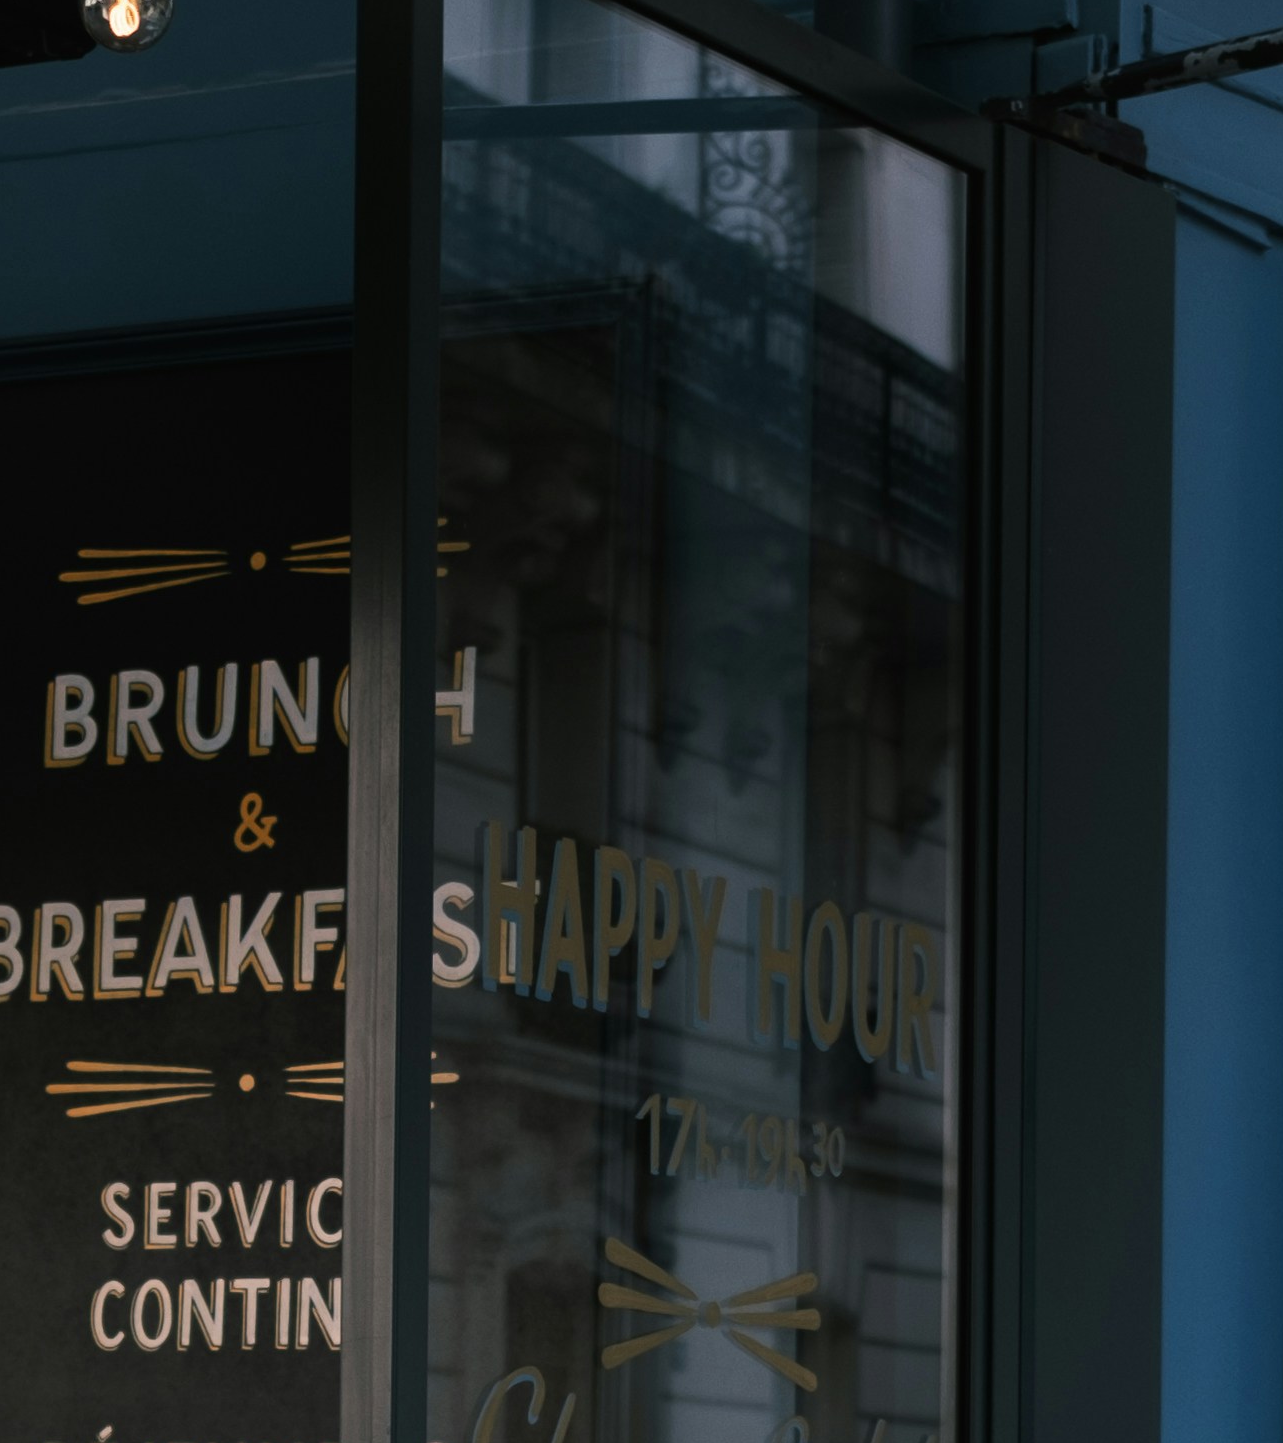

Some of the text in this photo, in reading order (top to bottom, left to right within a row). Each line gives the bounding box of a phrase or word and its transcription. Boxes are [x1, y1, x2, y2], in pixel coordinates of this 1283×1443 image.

[43, 646, 477, 769] BRUNH
[233, 792, 278, 853] &
[481, 818, 939, 1081] HAPPY HOUR
[100, 1176, 344, 1250] SERVIC
[89, 1277, 342, 1351] CONTIN
